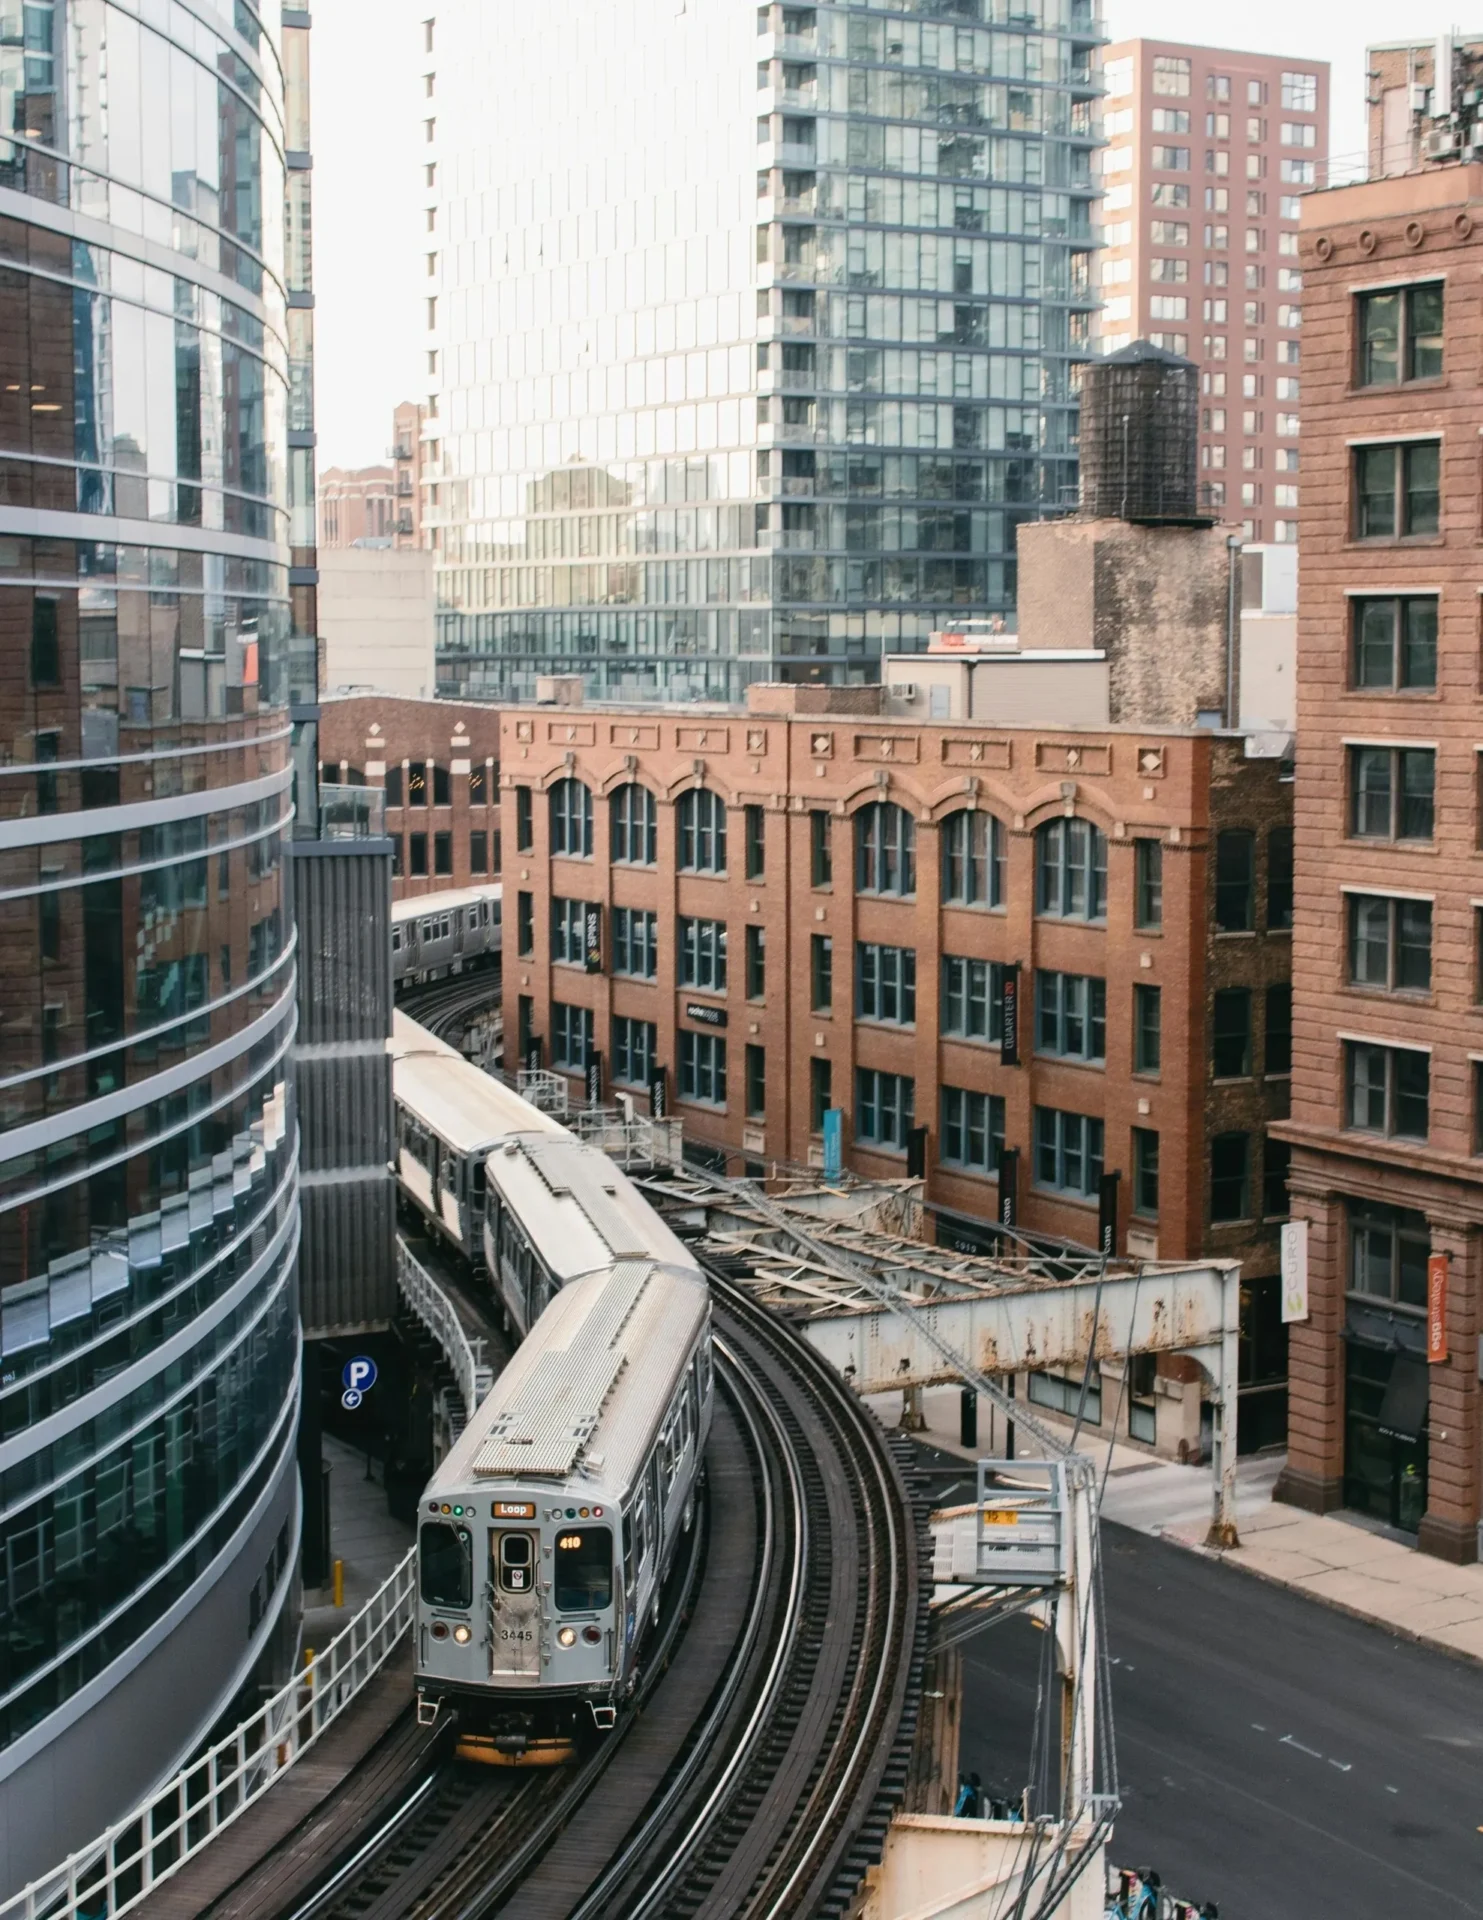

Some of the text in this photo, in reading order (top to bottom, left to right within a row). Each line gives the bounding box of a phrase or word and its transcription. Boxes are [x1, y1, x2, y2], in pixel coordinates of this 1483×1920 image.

[587, 912, 597, 948] SPINS
[1287, 1230, 1298, 1291] CURO
[1431, 1268, 1444, 1352] eggstrategy
[350, 1361, 369, 1388] P
[501, 1504, 527, 1516] Loop
[560, 1536, 581, 1549] 410
[501, 1629, 533, 1641] 3445
